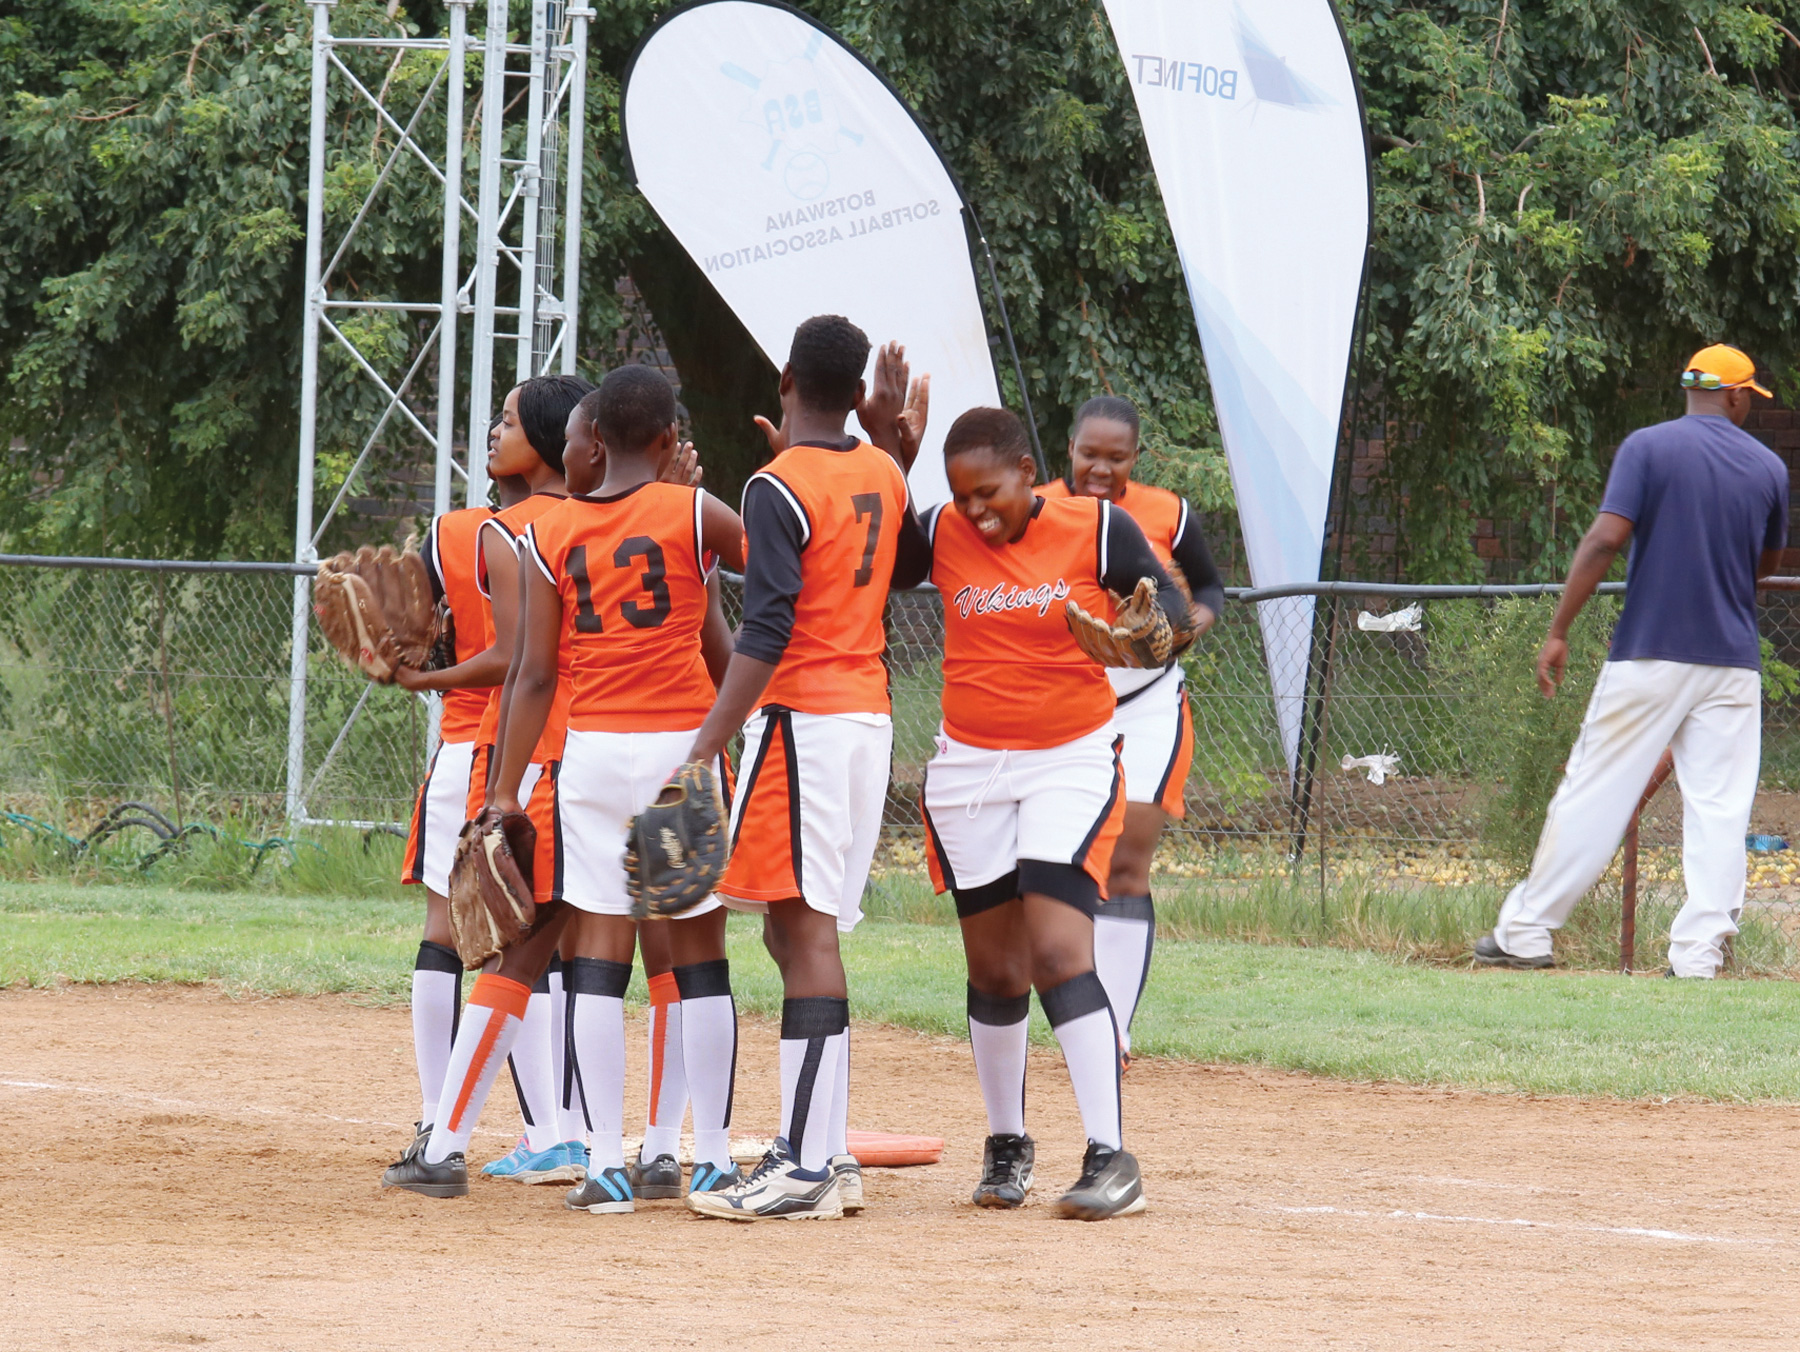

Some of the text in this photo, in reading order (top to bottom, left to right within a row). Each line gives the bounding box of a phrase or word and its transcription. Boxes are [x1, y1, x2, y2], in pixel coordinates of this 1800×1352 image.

[564, 535, 671, 634] 13
[850, 492, 883, 588] 7
[954, 578, 1070, 618] Vikings
